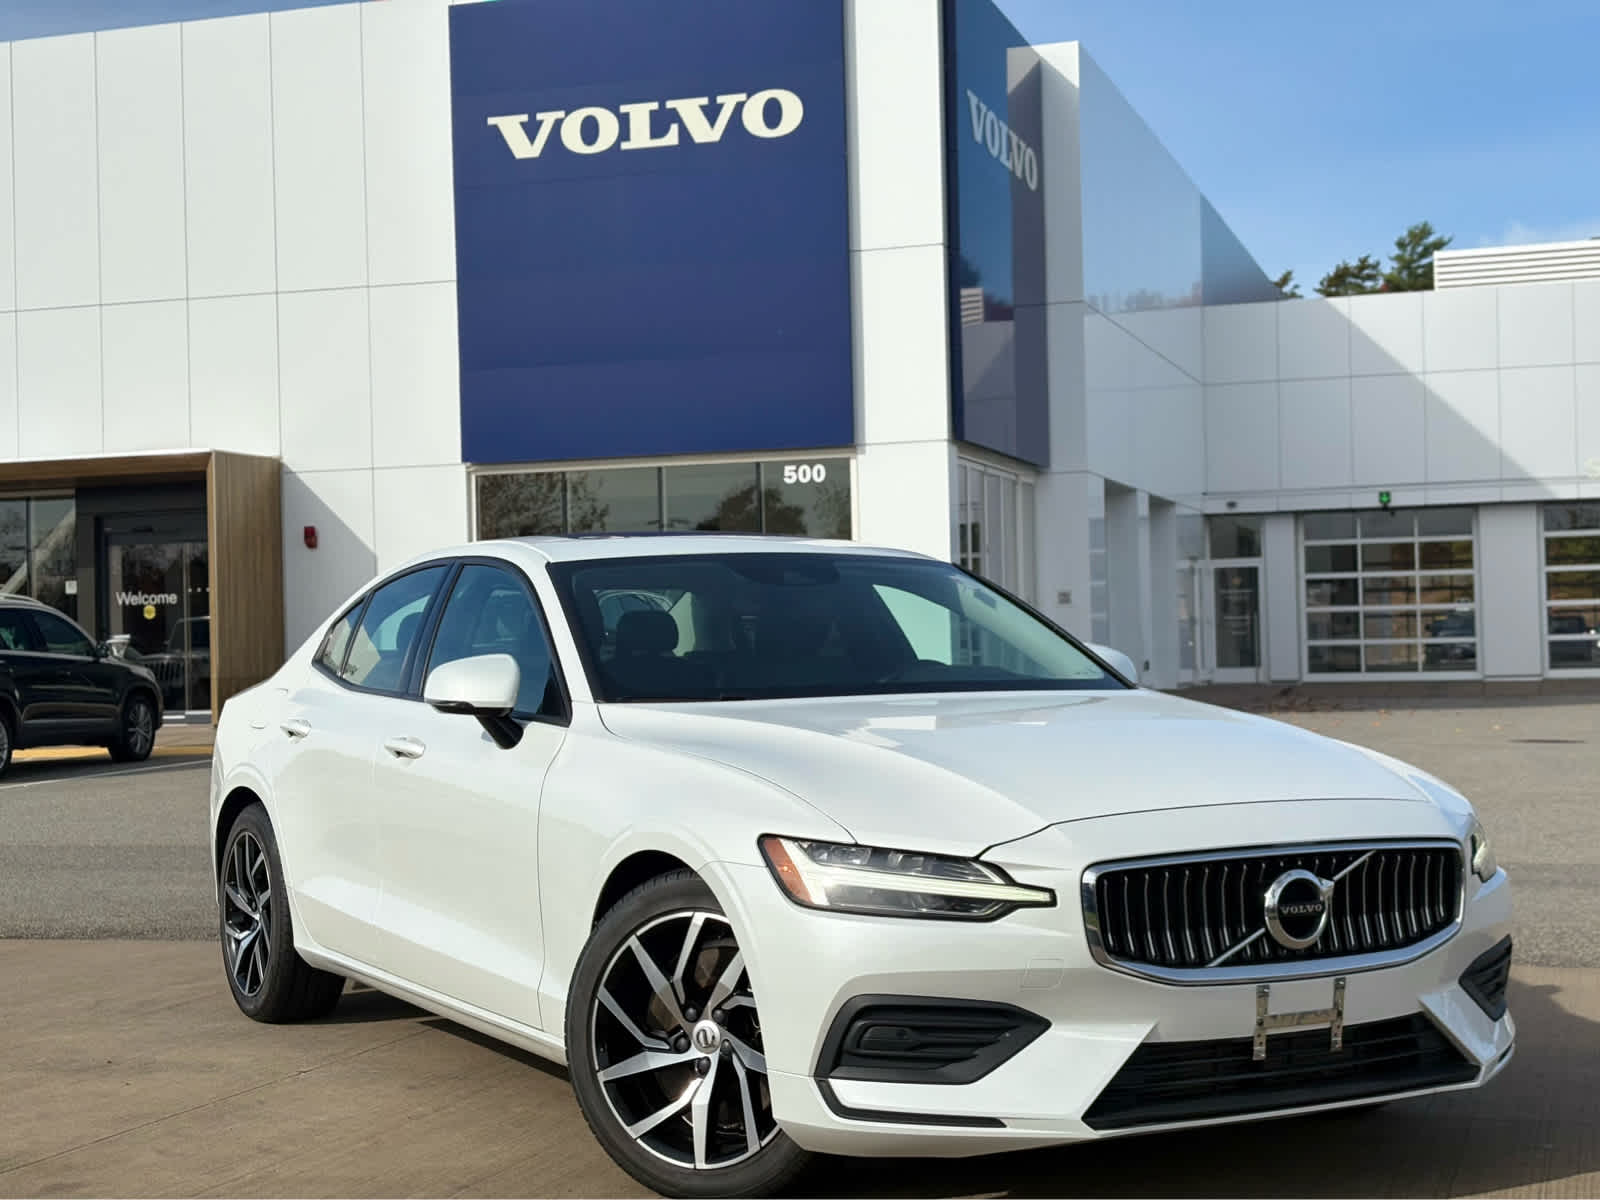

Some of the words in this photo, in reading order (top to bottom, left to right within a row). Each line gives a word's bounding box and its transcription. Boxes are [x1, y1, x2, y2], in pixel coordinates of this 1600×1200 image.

[487, 88, 804, 160] VOLVO
[966, 88, 1038, 192] VOLVO
[783, 463, 826, 484] 500
[115, 591, 178, 606] Welcome
[1280, 903, 1323, 914] VOLVO
